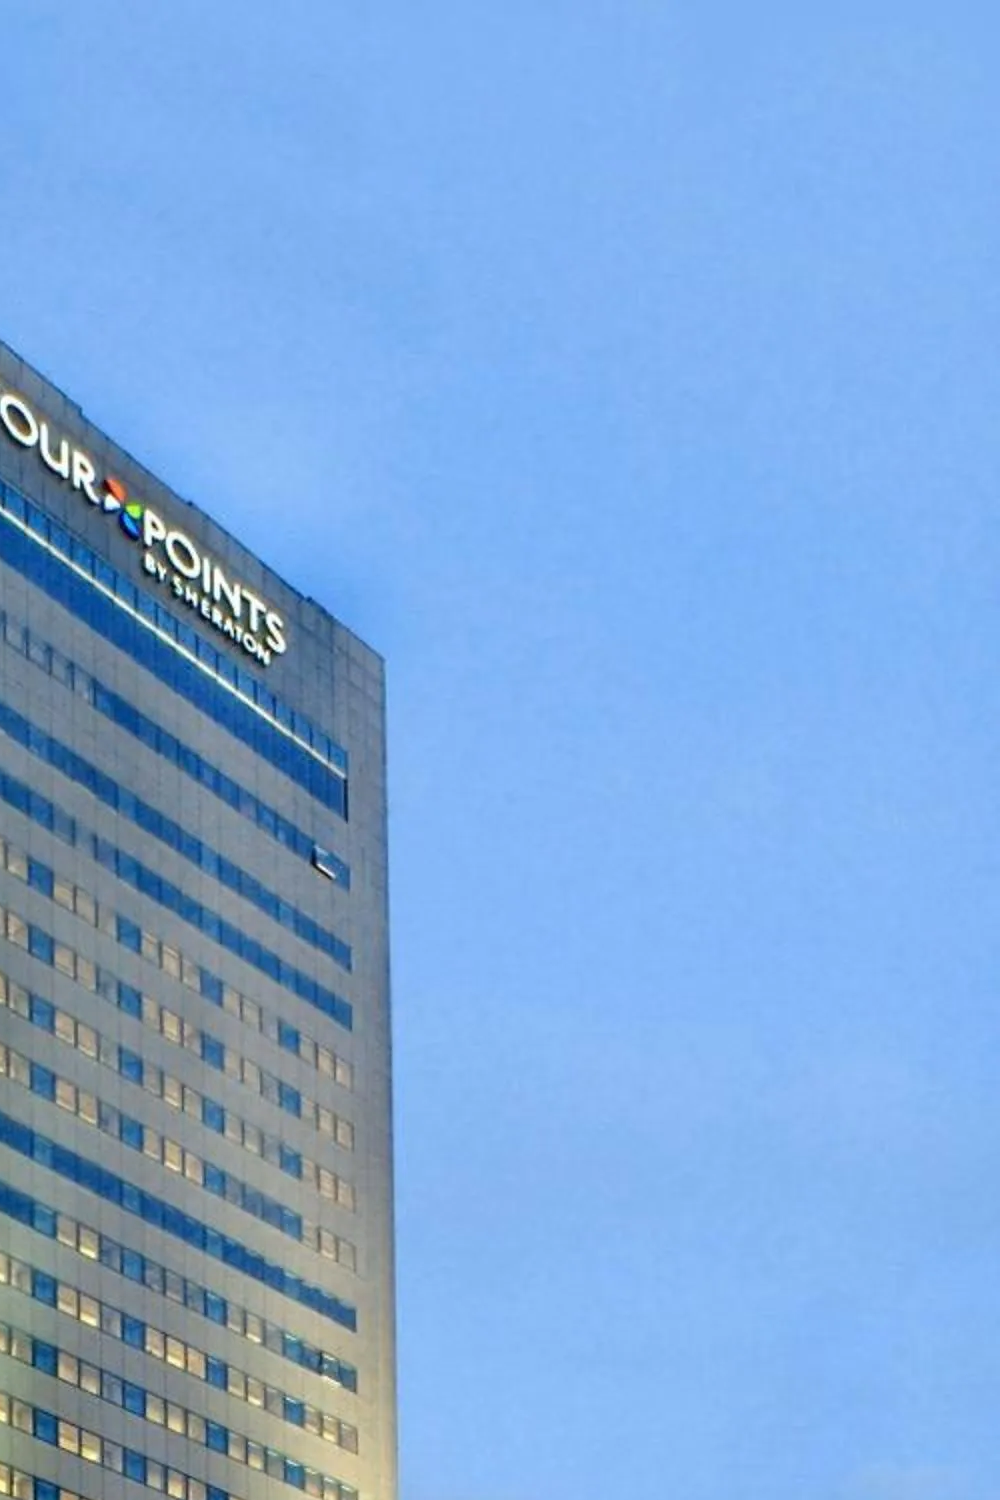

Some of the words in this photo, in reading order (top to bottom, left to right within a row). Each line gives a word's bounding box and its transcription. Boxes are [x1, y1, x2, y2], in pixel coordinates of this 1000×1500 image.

[143, 509, 287, 655] POINTS
[143, 552, 167, 582] BY
[173, 575, 271, 666] SHERATON
